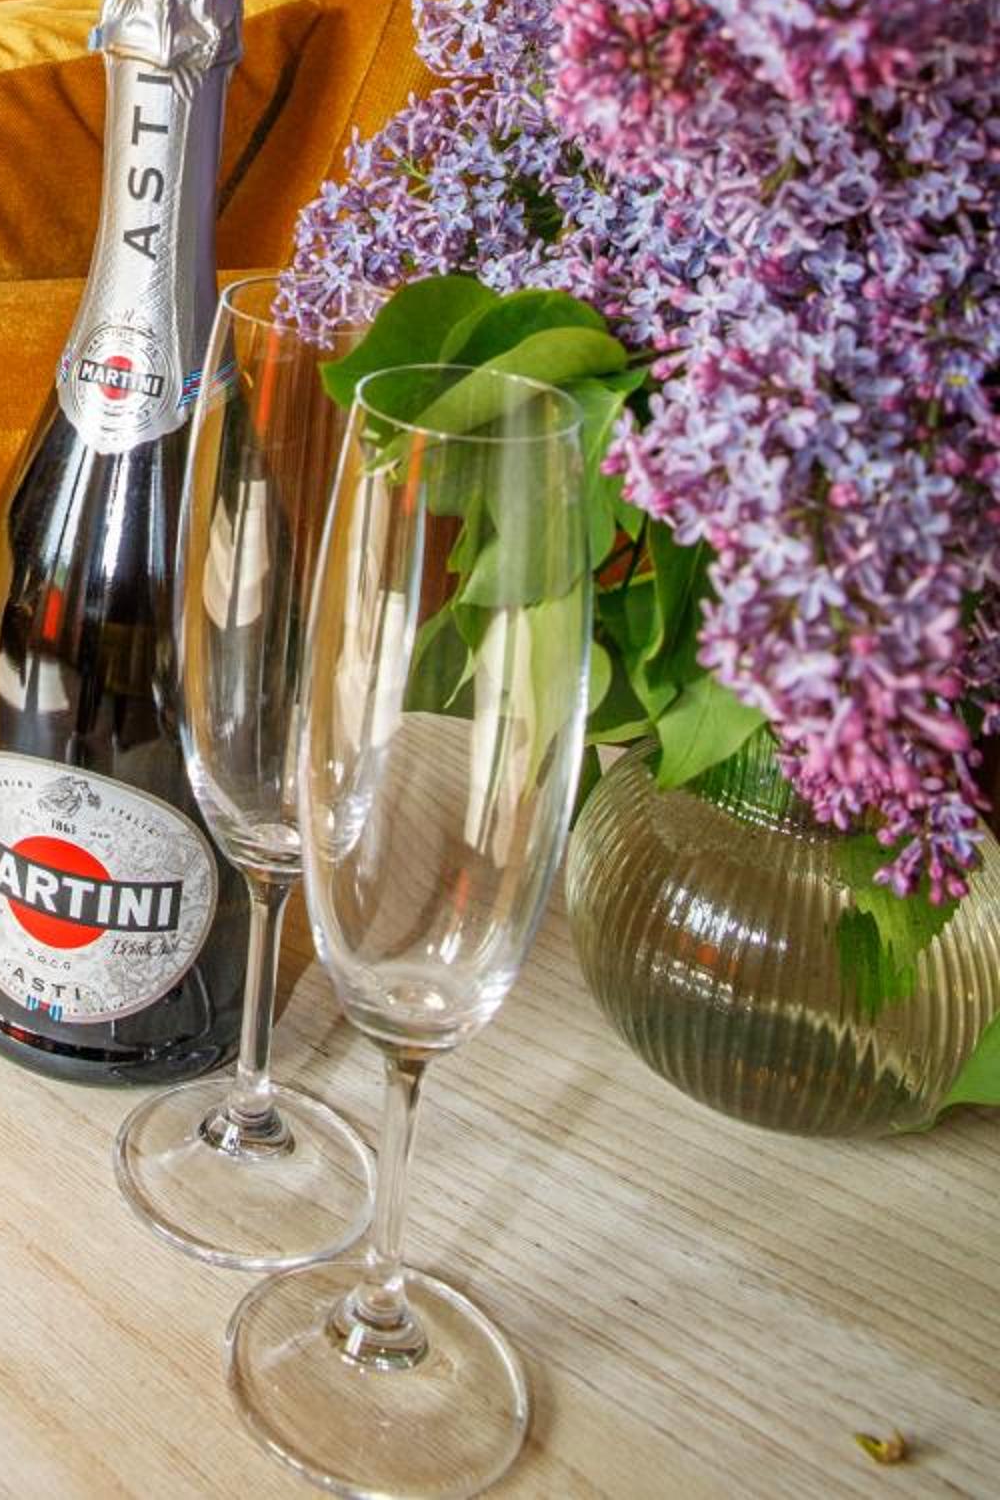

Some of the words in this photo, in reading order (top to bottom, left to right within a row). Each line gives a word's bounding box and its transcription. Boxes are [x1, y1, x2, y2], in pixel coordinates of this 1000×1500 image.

[123, 71, 171, 261] ASTI
[79, 359, 163, 397] MARTINI
[12, 966, 81, 1001] ASTI
